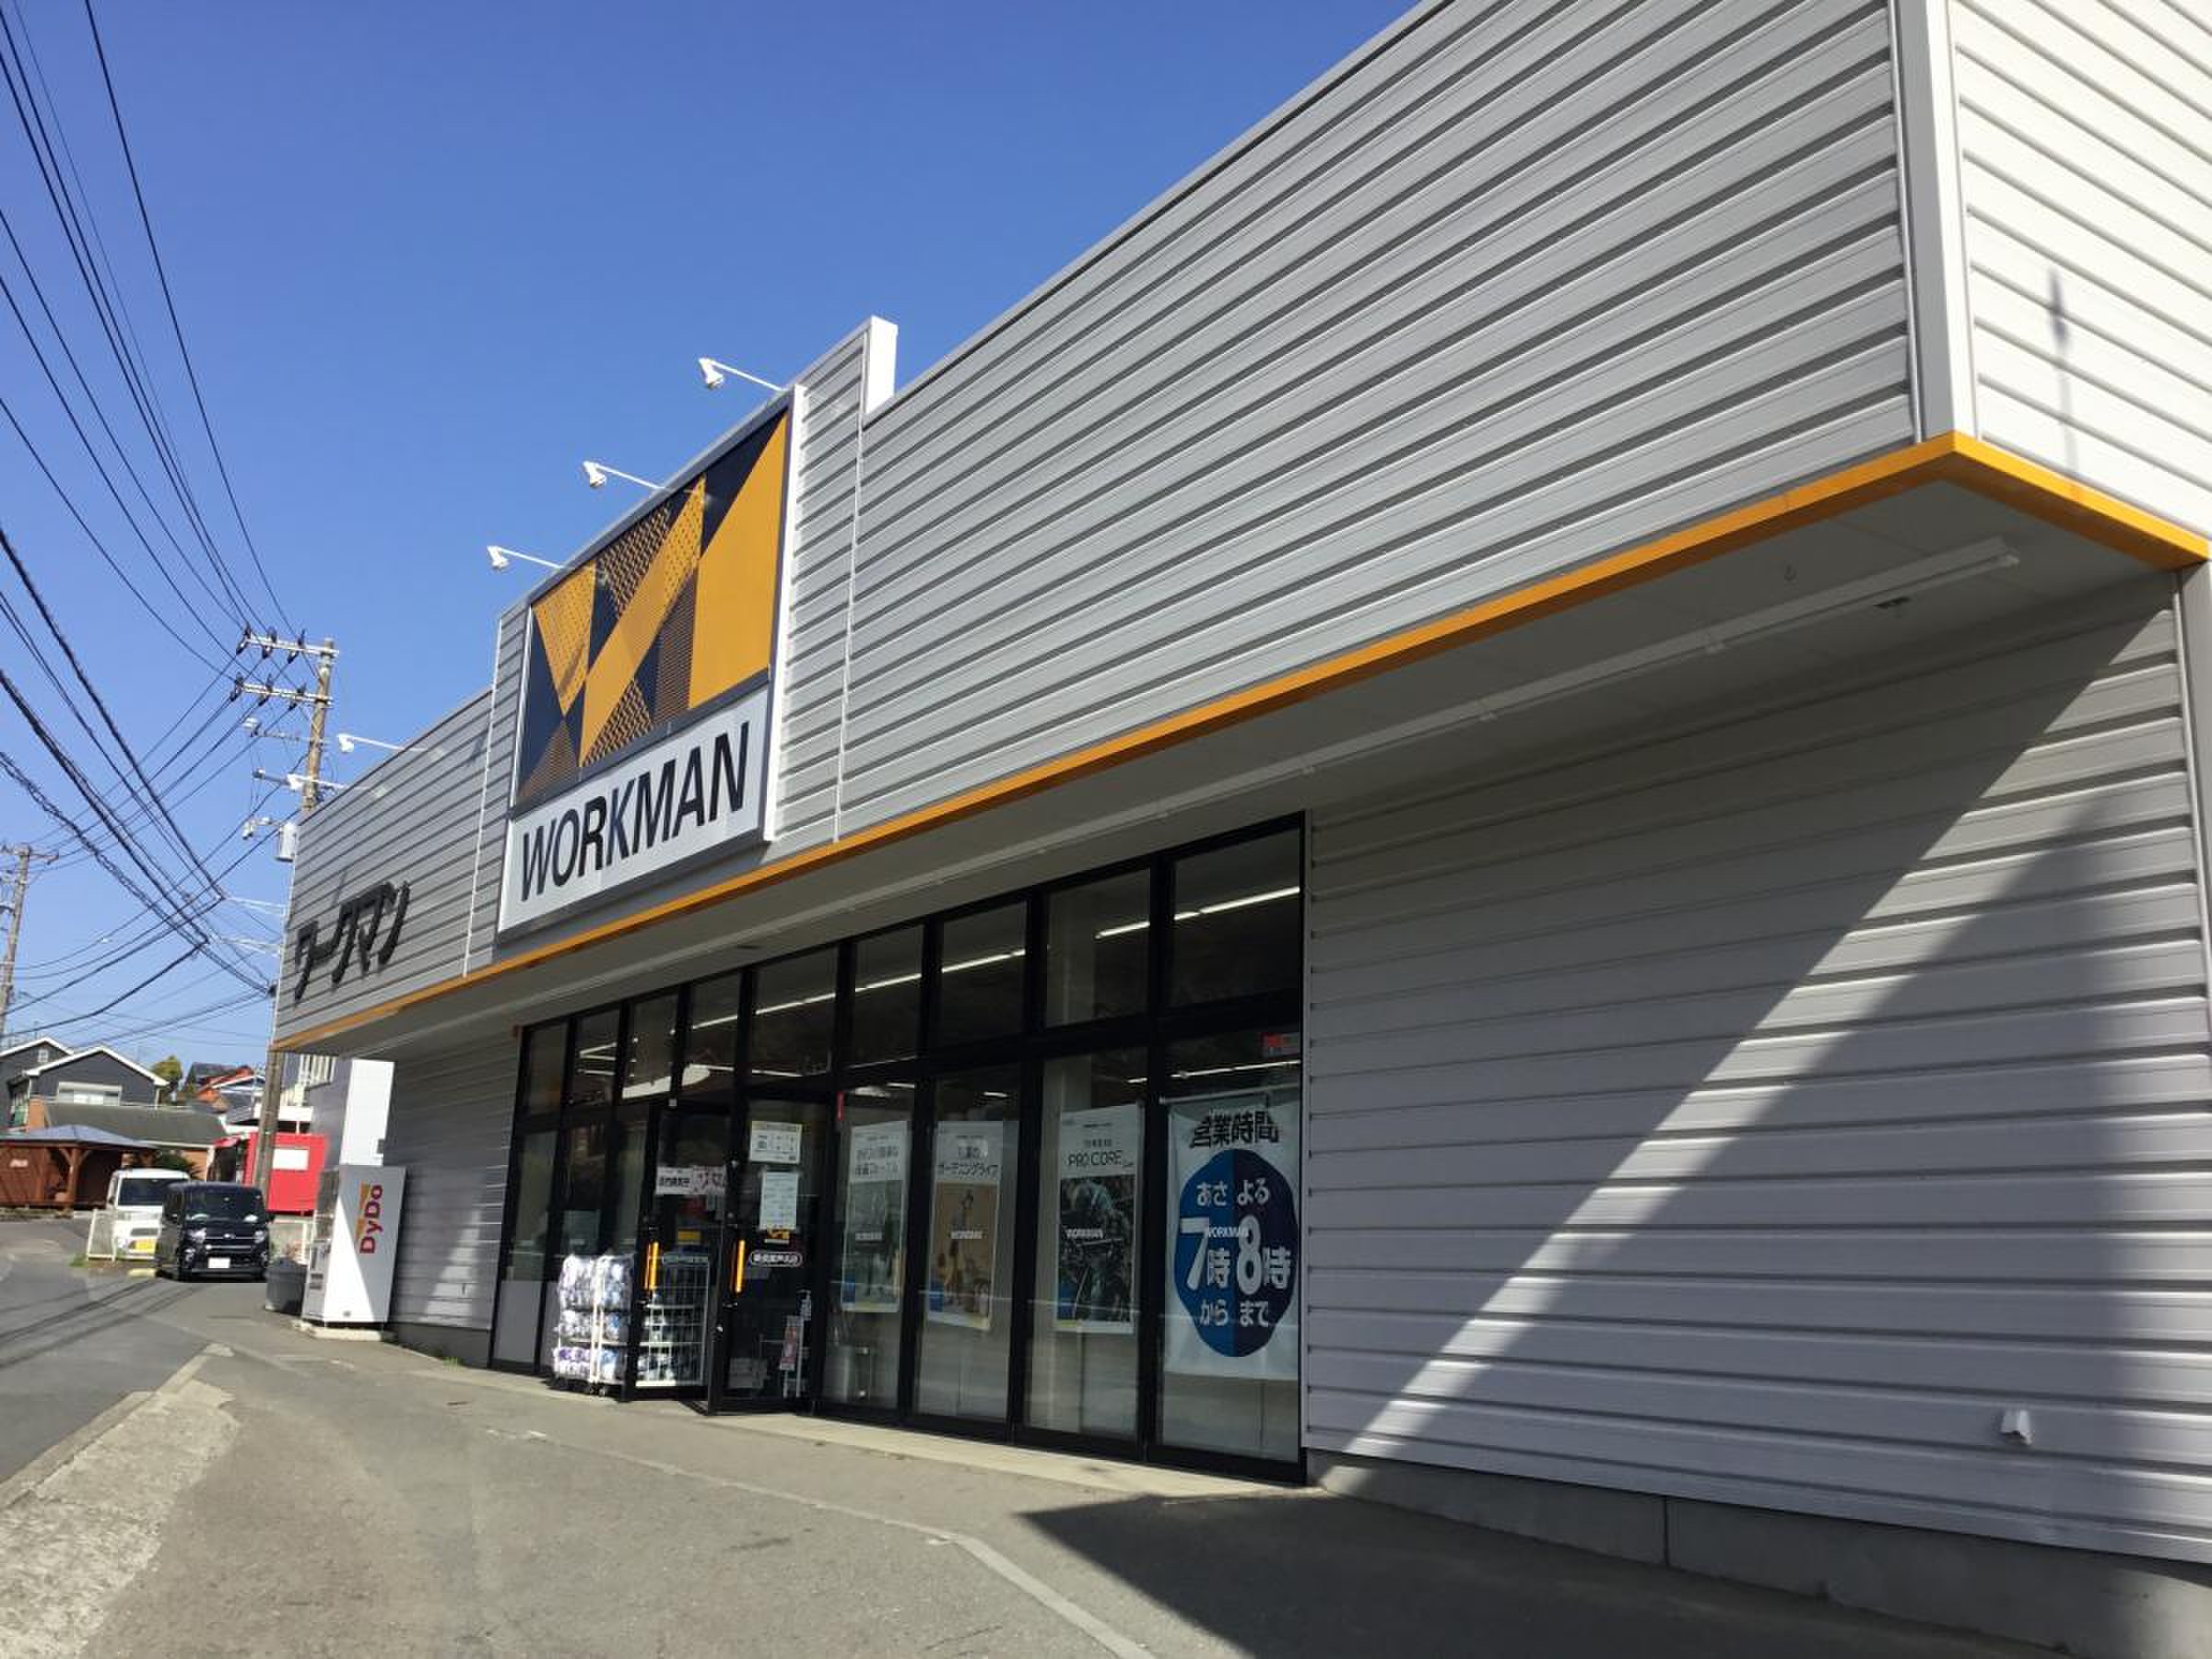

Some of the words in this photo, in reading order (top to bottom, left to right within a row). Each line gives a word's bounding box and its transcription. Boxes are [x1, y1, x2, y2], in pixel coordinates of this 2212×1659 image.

[521, 722, 750, 902] WORKMAN
[1189, 1109, 1280, 1149] 営業時間
[359, 1184, 383, 1254] DyDo
[1196, 1180, 1228, 1207] あさ
[1237, 1179, 1271, 1206] よる
[1180, 1216, 1232, 1291] 7時
[1236, 1214, 1292, 1296] 8時
[1200, 1300, 1230, 1327] から
[1240, 1300, 1270, 1328] まで
